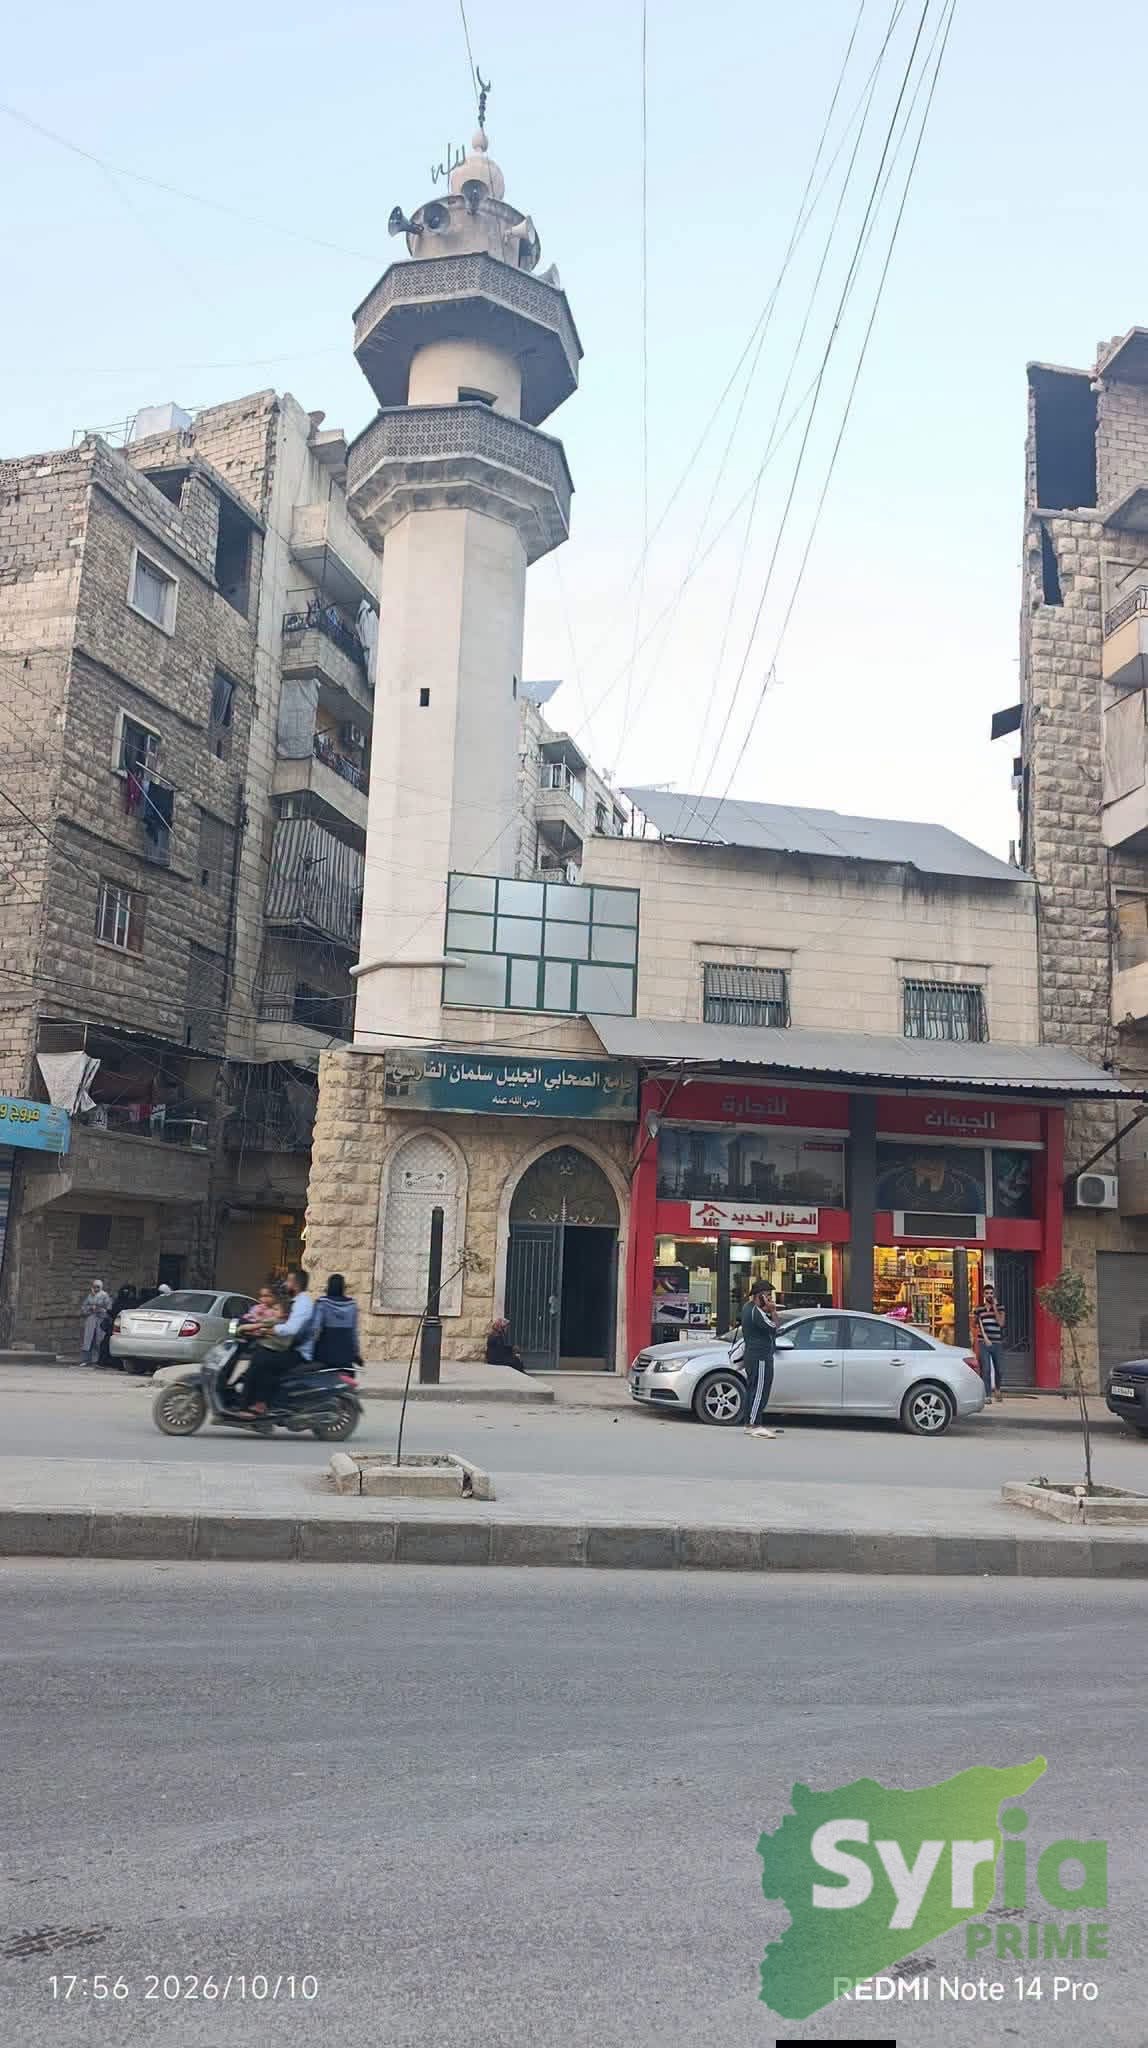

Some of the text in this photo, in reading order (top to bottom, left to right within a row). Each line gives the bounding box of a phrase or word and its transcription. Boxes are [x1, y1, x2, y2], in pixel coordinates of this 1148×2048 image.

[449, 1064, 493, 1083] سلمان
[496, 1066, 541, 1088] الجليل
[544, 1069, 600, 1091] الصحابي
[603, 1071, 633, 1093] جامع
[492, 1096, 541, 1109] رضي الله عنه
[703, 1217, 720, 1227] MG
[731, 1211, 817, 1227] المنزل الجديد
